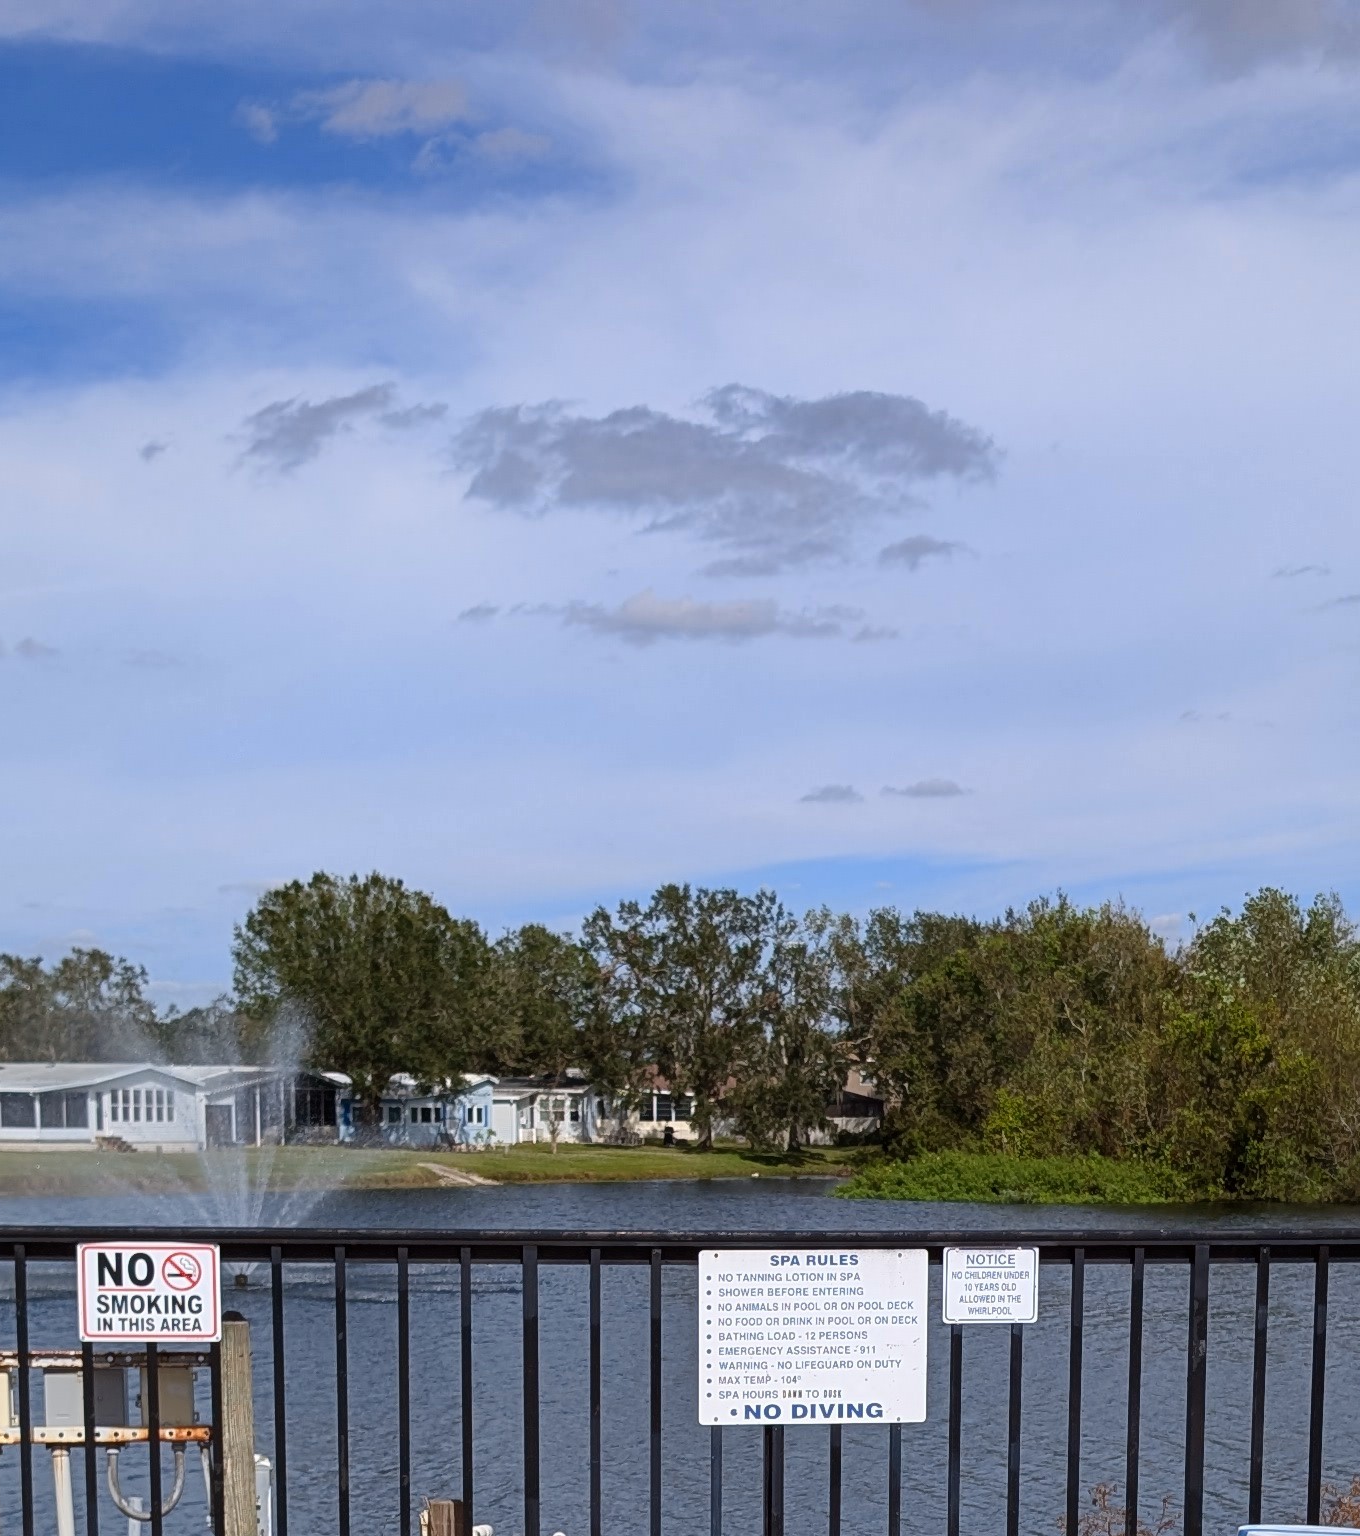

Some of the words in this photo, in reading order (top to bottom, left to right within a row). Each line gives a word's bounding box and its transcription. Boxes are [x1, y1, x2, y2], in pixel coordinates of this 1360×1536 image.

[770, 1255, 800, 1266] SPA
[806, 1254, 859, 1266] RULES
[966, 1254, 1016, 1265] NOTICE
[97, 1252, 155, 1287] NO
[718, 1273, 733, 1282] NO
[736, 1273, 782, 1282] TANNING
[786, 1273, 824, 1282] LOTION
[827, 1273, 837, 1281] IN
[840, 1272, 860, 1281] SPA
[951, 1271, 962, 1279] NO
[965, 1271, 1002, 1279] CHILDREN
[1004, 1271, 1030, 1279] UNDER
[718, 1288, 764, 1297] SHOWER
[767, 1288, 808, 1297] BEFORE
[812, 1287, 864, 1296] ENTERING
[964, 1283, 972, 1291] 10
[974, 1283, 1000, 1291] YEARS
[1001, 1283, 1017, 1291] OLD
[96, 1294, 203, 1314] SMOKING
[959, 1295, 995, 1303] ALLOWED
[998, 1295, 1005, 1303] IN
[1007, 1295, 1021, 1303] THE
[718, 1303, 732, 1311] NO
[735, 1302, 779, 1311] ANIMALS
[781, 1302, 791, 1311] IN
[794, 1302, 820, 1311] POOL
[824, 1302, 838, 1310] OR
[840, 1302, 855, 1310] ON
[857, 1301, 884, 1310] POOL
[887, 1301, 914, 1310] DECK
[968, 1306, 1012, 1315] WHIRLPOOL
[97, 1318, 113, 1332] IN
[118, 1318, 155, 1332] THIS
[160, 1318, 202, 1332] AREA
[718, 1318, 732, 1326] NO
[735, 1318, 762, 1326] FOOD
[765, 1317, 780, 1326] OR
[782, 1317, 813, 1326] DRINK
[815, 1317, 825, 1325] IN
[828, 1317, 854, 1325] POOL
[857, 1316, 871, 1325] OR
[874, 1316, 888, 1324] ON
[891, 1316, 918, 1324] DECK
[718, 1332, 764, 1341] BATHING
[767, 1332, 795, 1341] LOAD
[805, 1332, 816, 1340] 12
[818, 1331, 868, 1340] PERSONS
[718, 1346, 783, 1355] EMERGENCY
[786, 1346, 851, 1355] ASSISTANCE
[860, 1346, 876, 1354] 911
[719, 1361, 768, 1370] WARNING
[777, 1361, 792, 1370] NO
[795, 1360, 854, 1369] LIFEGUARD
[856, 1360, 871, 1369] ON
[874, 1359, 901, 1368] DUTY
[718, 1376, 740, 1384] MAX
[743, 1376, 771, 1384] TEMP
[718, 1391, 739, 1399] SPA
[742, 1390, 779, 1399] HOURS
[782, 1390, 802, 1398] DAWN
[805, 1390, 819, 1398] TO
[823, 1389, 842, 1398] DUSK
[744, 1404, 782, 1419] NO
[791, 1403, 883, 1419] DIVING
